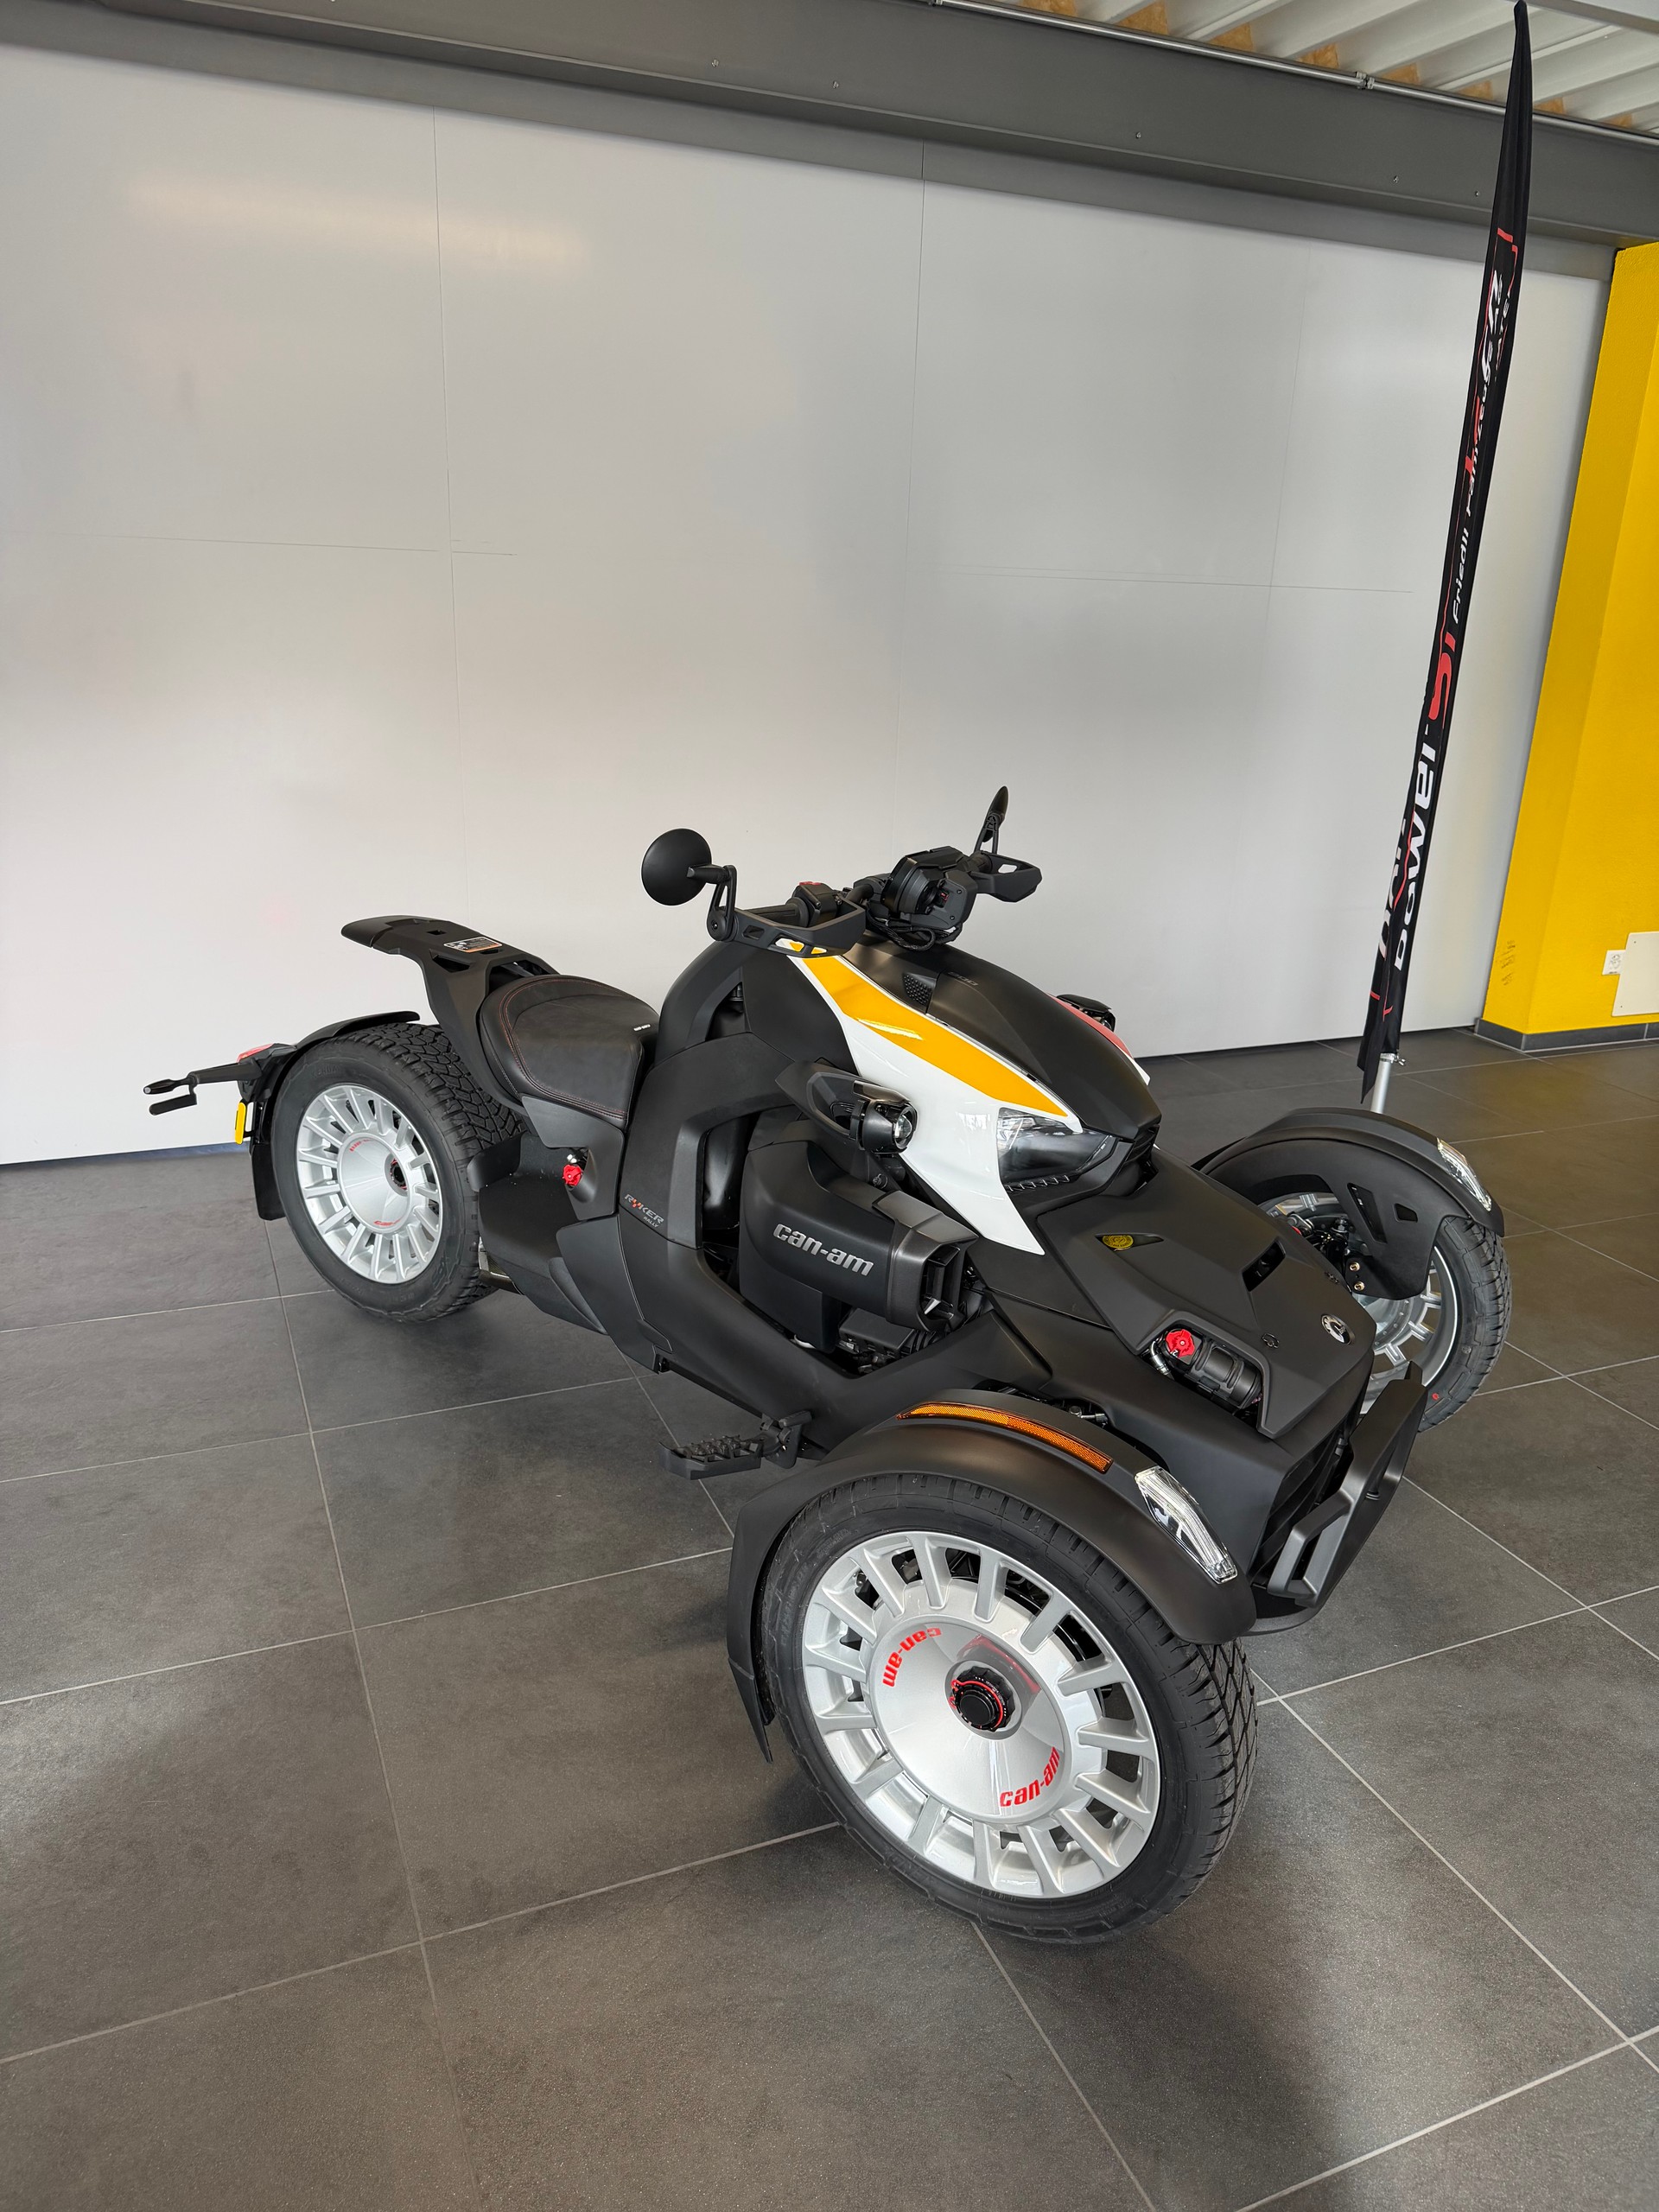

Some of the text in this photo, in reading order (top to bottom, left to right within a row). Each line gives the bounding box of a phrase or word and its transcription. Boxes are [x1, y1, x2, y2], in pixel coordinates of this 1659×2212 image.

[1452, 527, 1469, 624] Friedli
[625, 1194, 664, 1224] RYKER
[644, 1216, 659, 1228] RALLY
[773, 1224, 874, 1276] can-am
[882, 1627, 942, 1688] can-am
[1000, 1746, 1060, 1808] can-am
